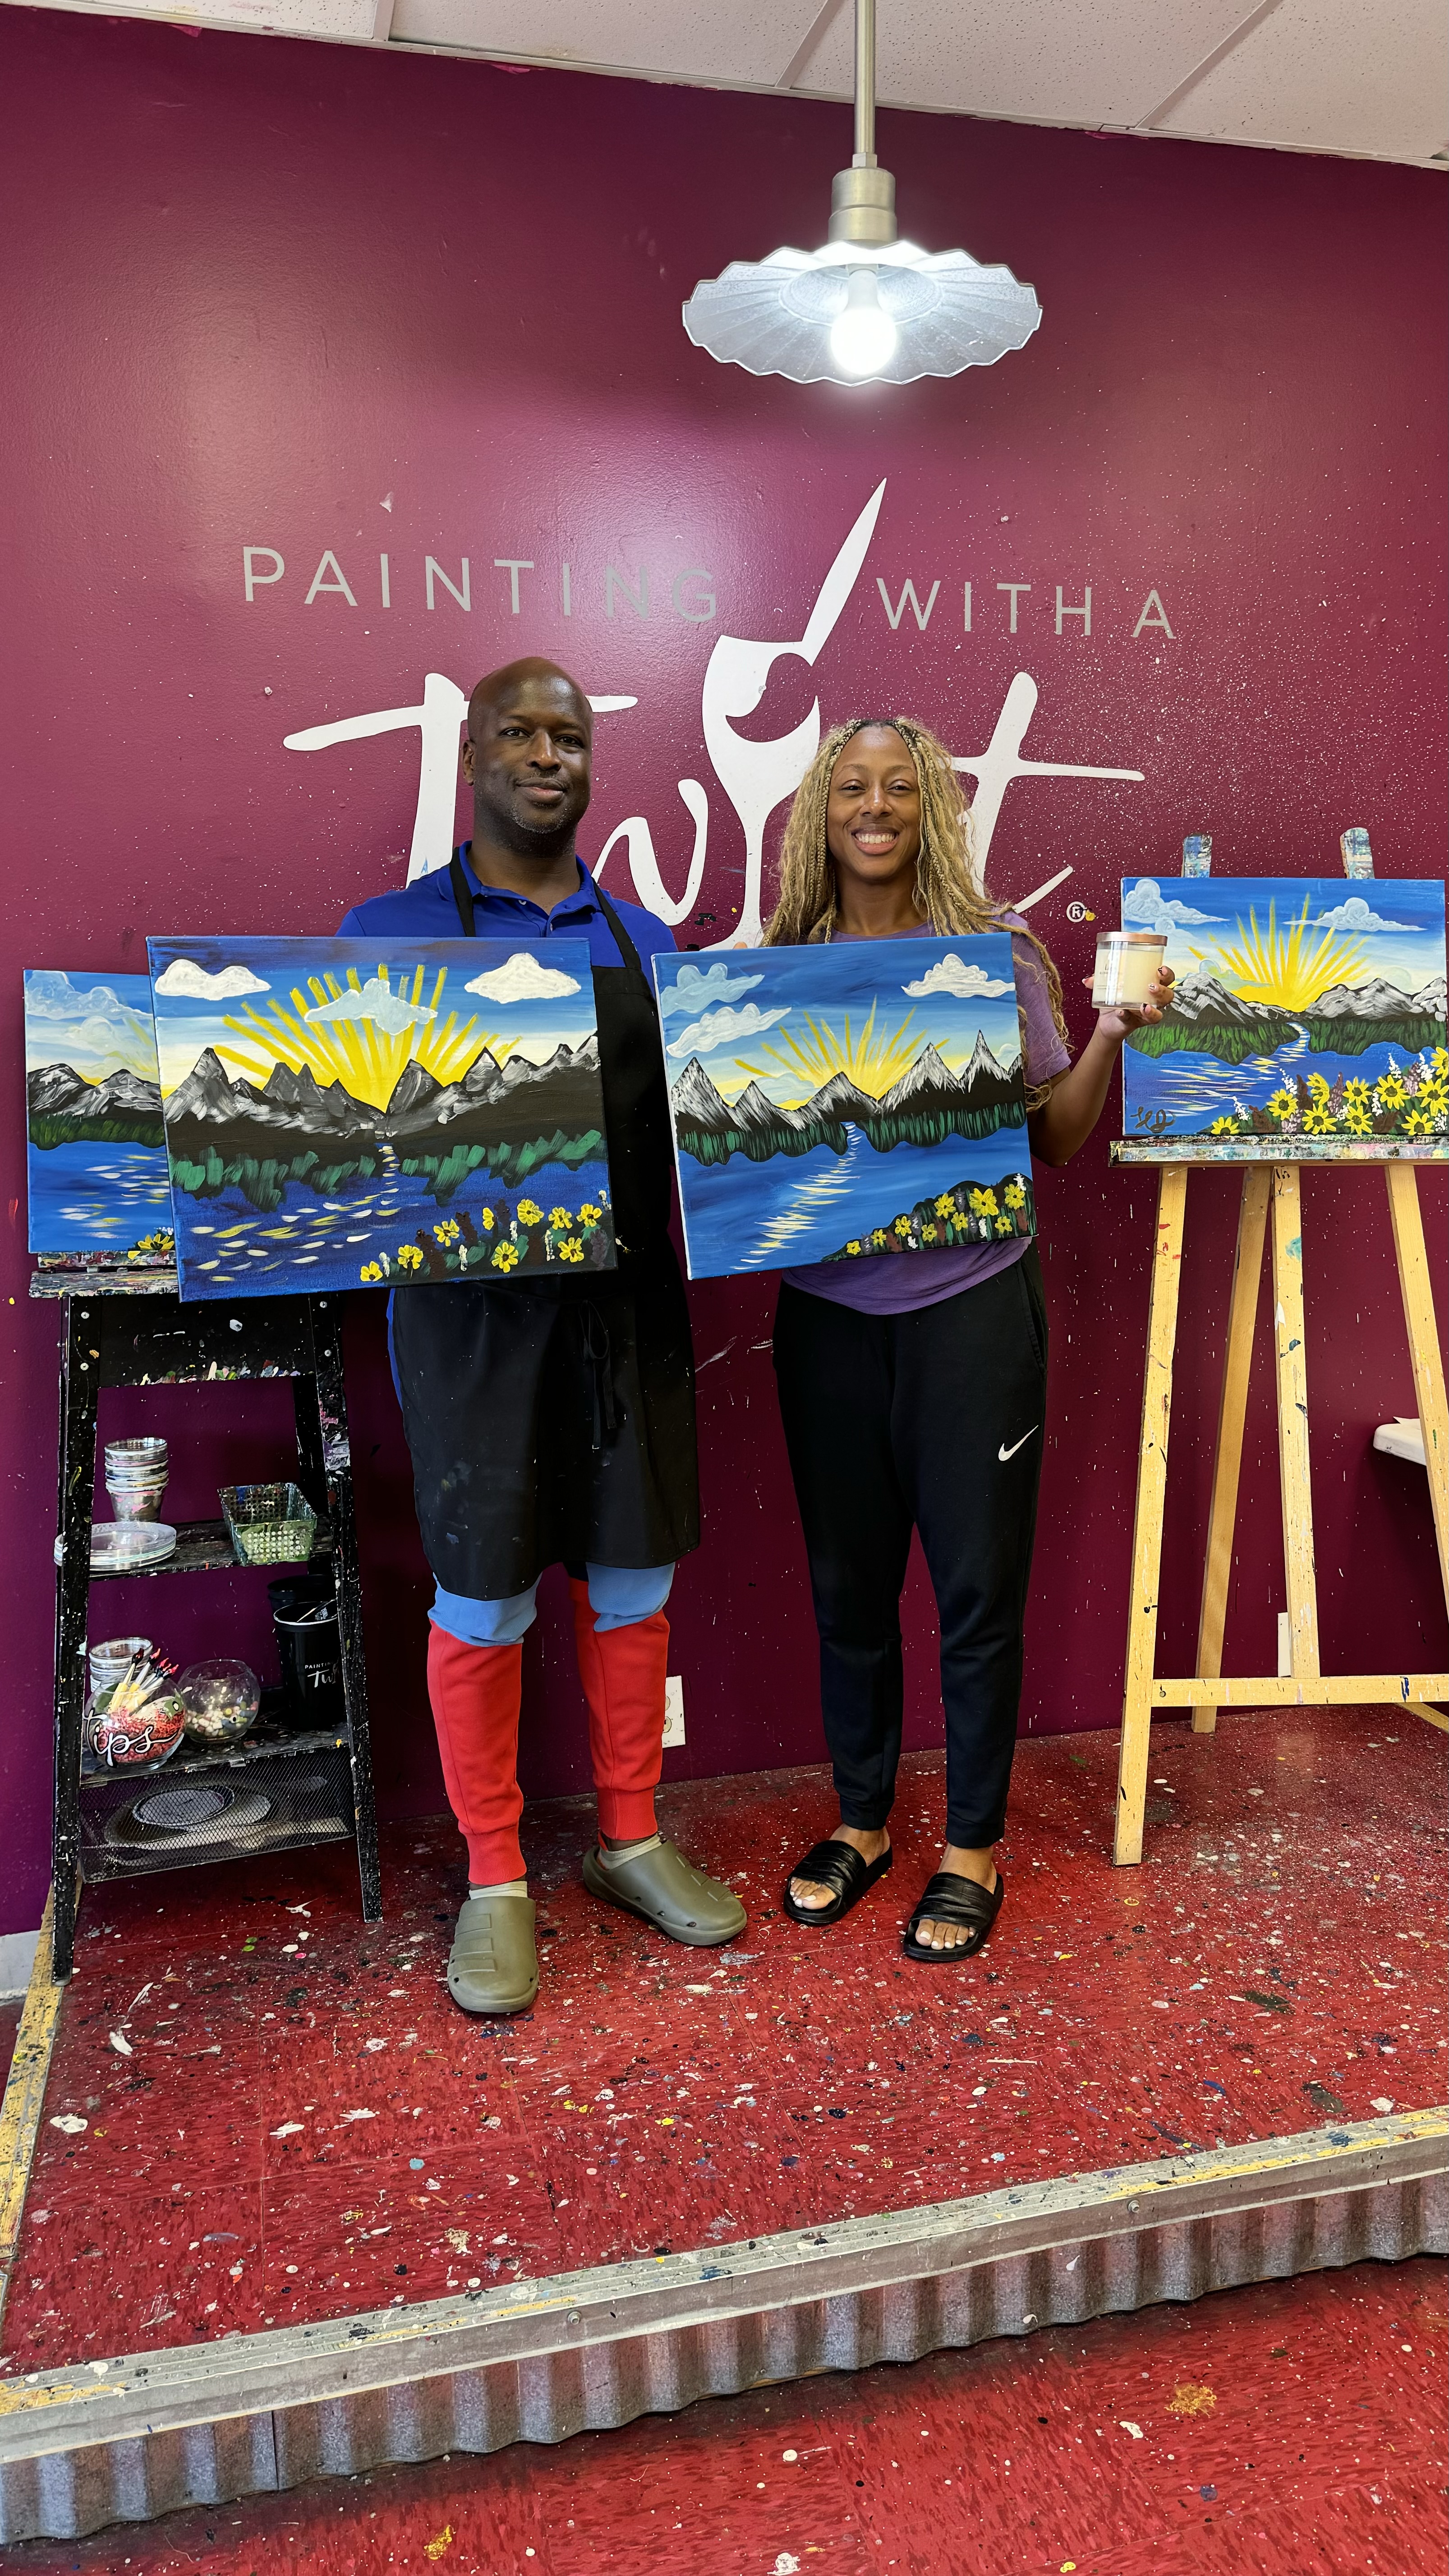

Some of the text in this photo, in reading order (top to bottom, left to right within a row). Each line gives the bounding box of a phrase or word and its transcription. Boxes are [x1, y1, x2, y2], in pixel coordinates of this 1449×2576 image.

[243, 546, 1177, 639] PAINTING WITH A
[83, 1708, 179, 1767] tips
